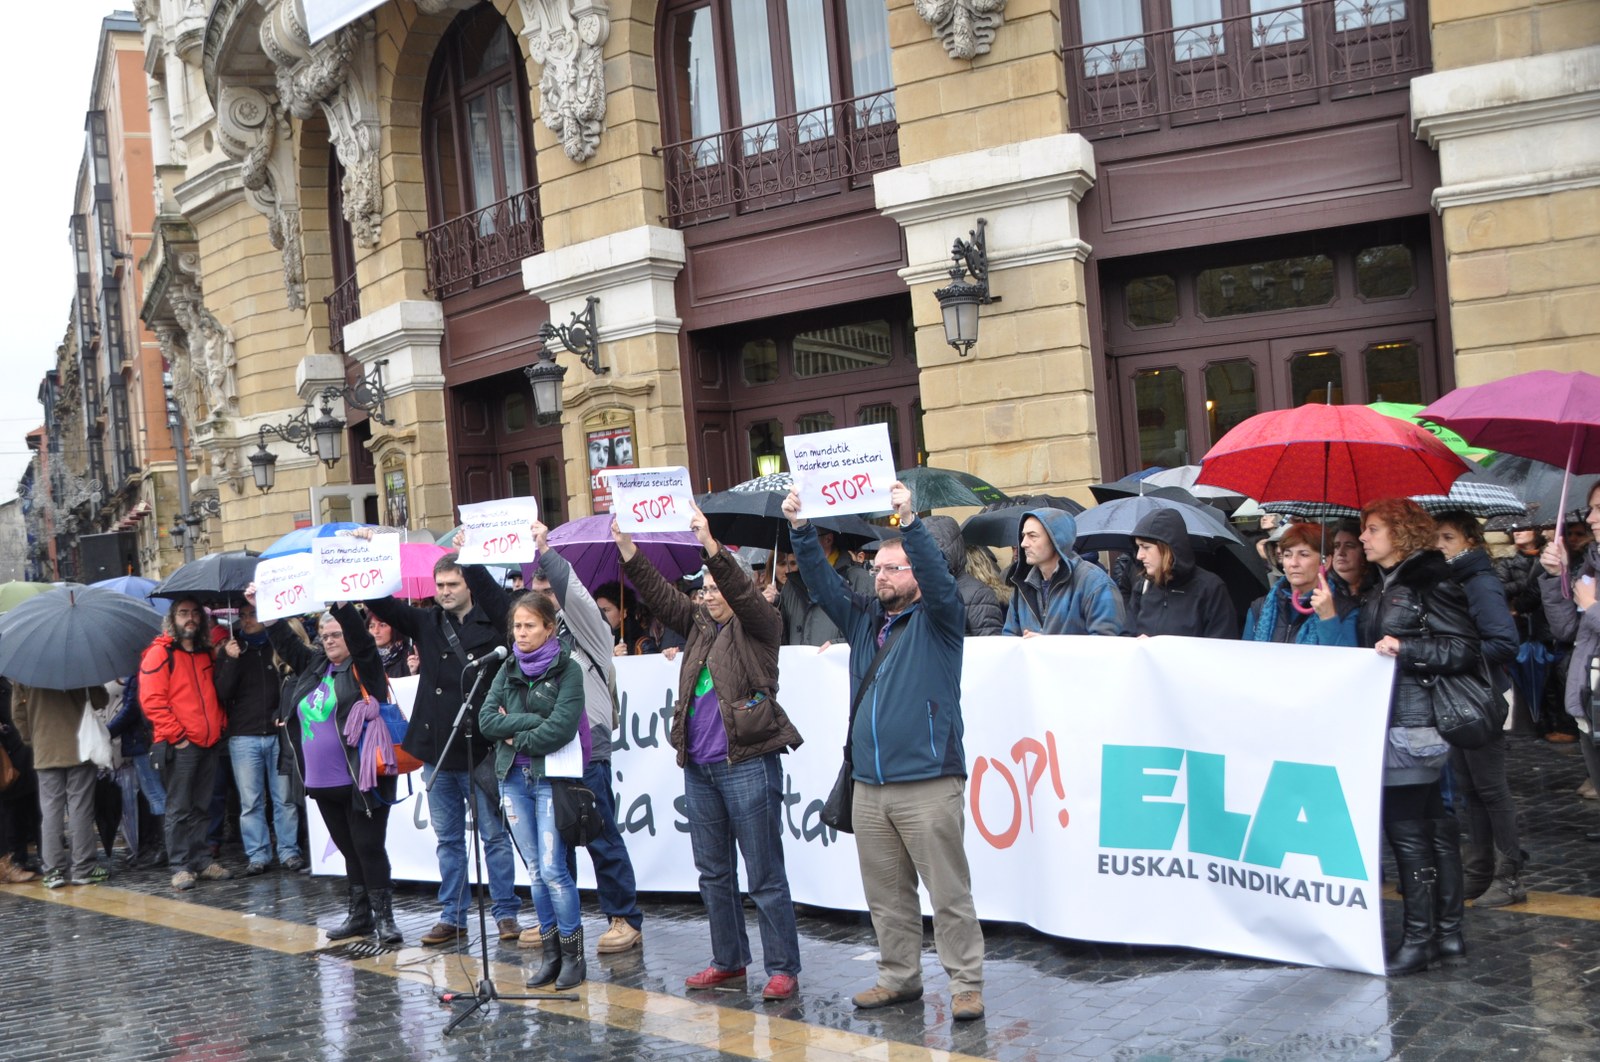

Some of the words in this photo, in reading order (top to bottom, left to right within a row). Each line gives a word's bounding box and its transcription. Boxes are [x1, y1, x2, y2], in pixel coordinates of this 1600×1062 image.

[794, 449, 808, 459] Lan
[810, 442, 851, 457] mundutik
[797, 458, 840, 471] indarkeria
[842, 451, 884, 466] sexistari
[617, 477, 650, 488] indarkeria
[652, 476, 683, 487] sexistari
[821, 472, 875, 506] STOP!
[632, 494, 676, 523] STOP!
[466, 521, 499, 530] ndarkeria
[321, 547, 335, 555] Lan
[483, 533, 521, 557] STOP!
[321, 556, 361, 565] indarkeria
[363, 554, 393, 563] sexistari
[341, 568, 384, 593] STOP!
[274, 584, 308, 610] STOP!
[969, 730, 1070, 850] OP!
[1098, 743, 1369, 881] ELA
[1097, 853, 1199, 880] EUSKAL
[1207, 862, 1368, 910] SINDIKATUA
